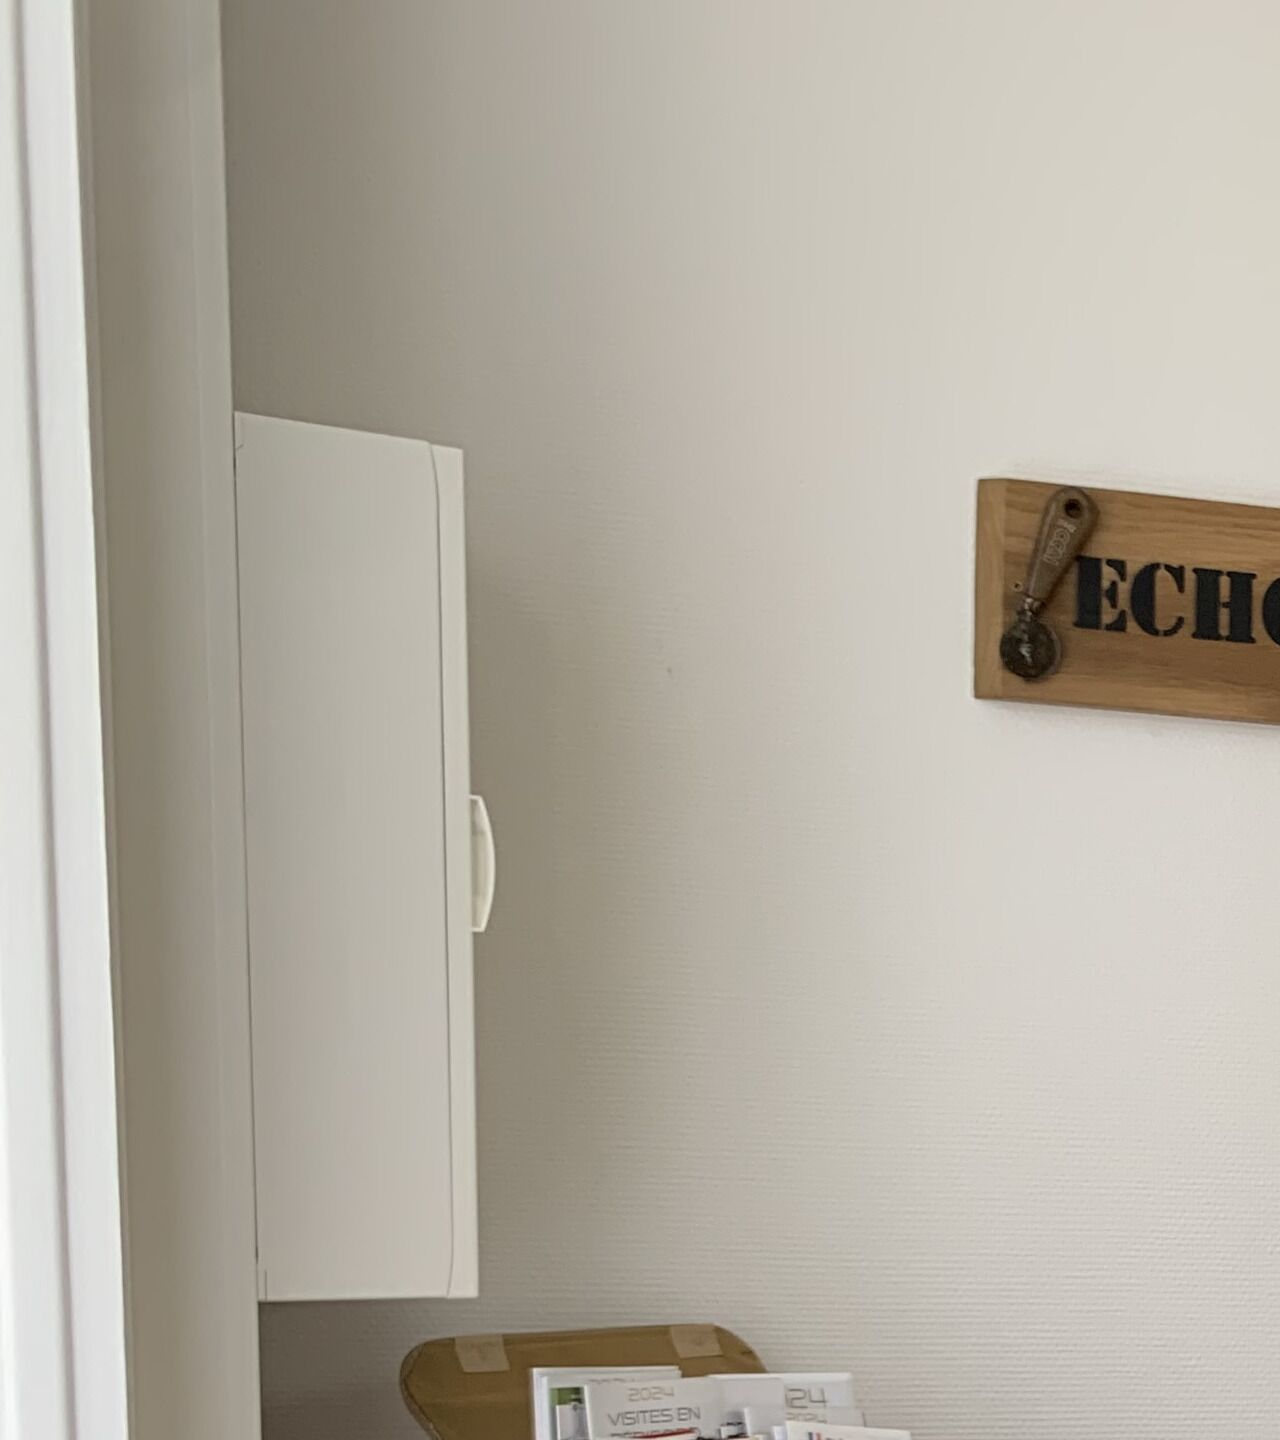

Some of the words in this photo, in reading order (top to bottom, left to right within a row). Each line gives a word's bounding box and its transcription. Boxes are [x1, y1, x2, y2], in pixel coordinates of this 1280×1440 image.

[627, 1385, 674, 1402] 2024
[607, 1407, 674, 1427] VISITES
[676, 1406, 702, 1422] EN
